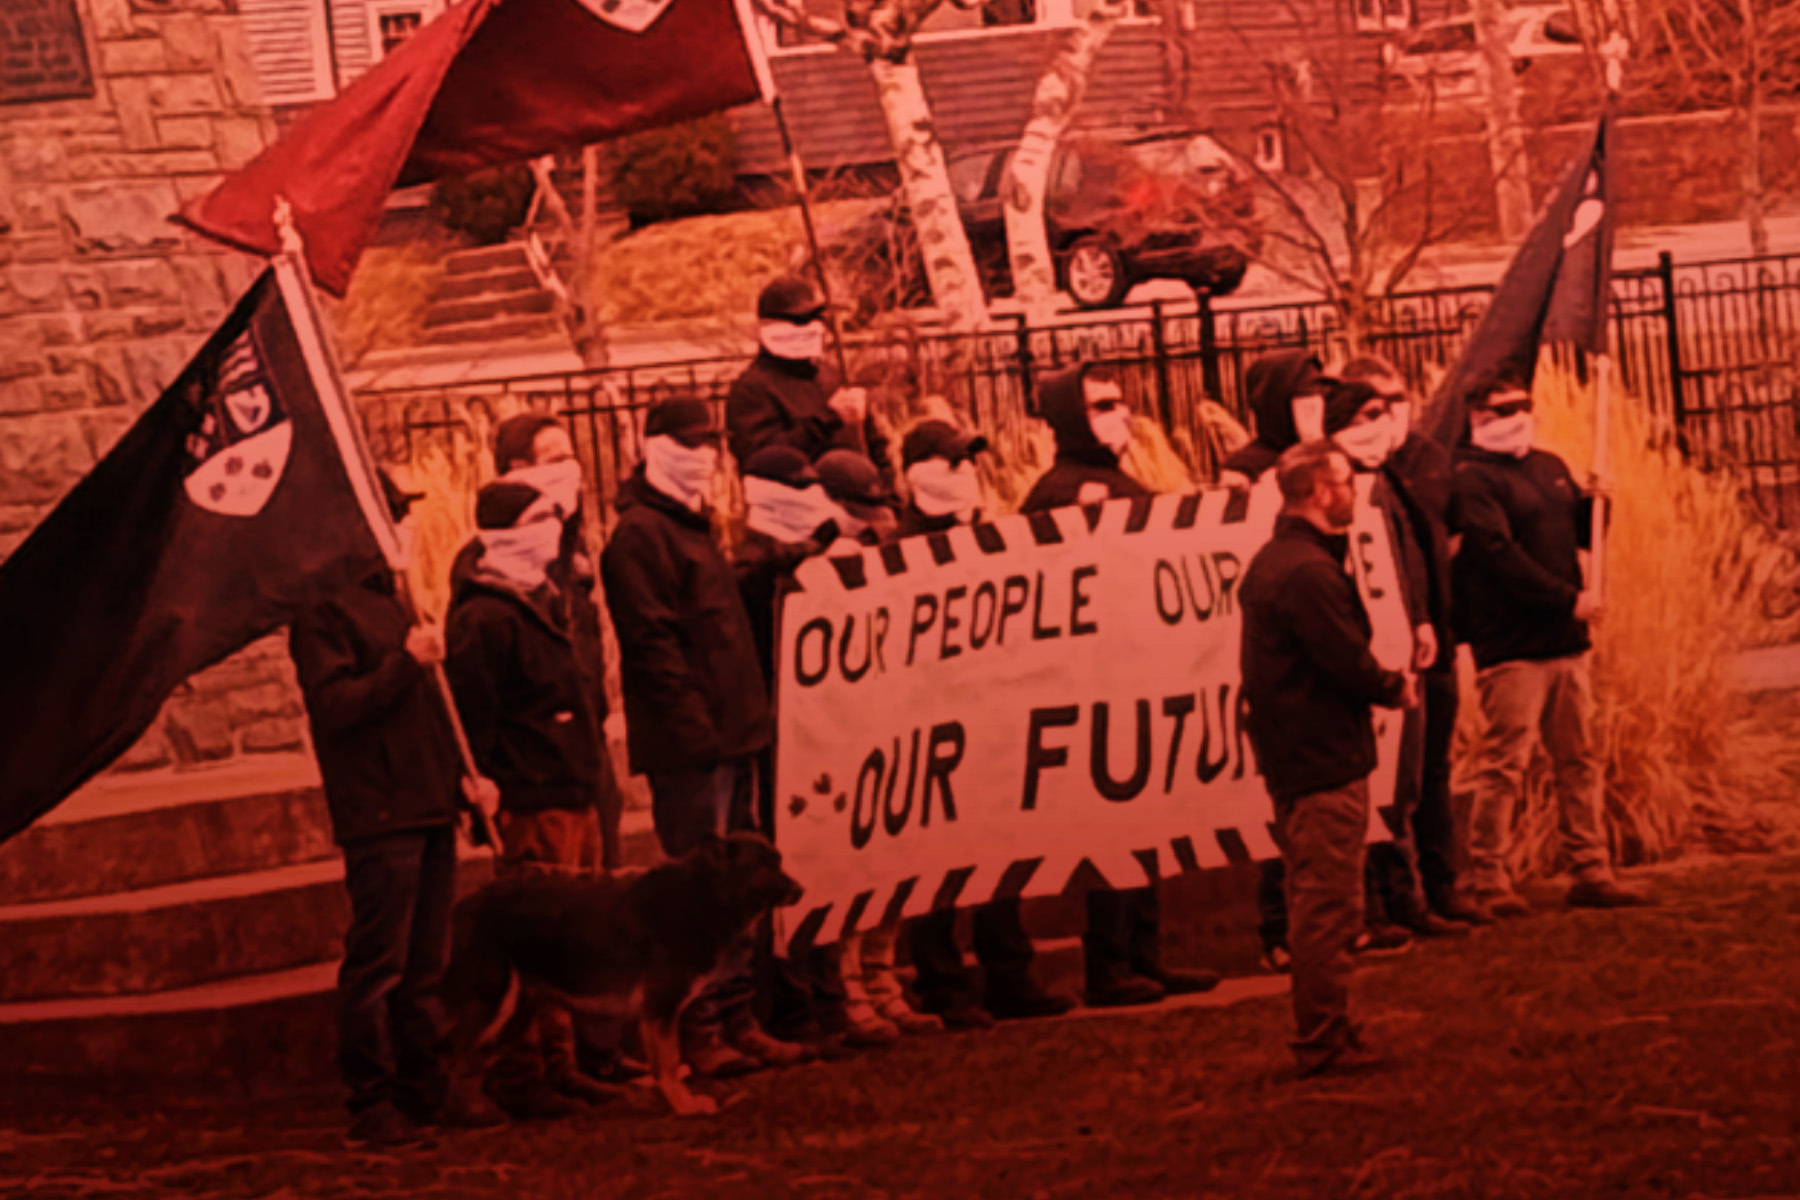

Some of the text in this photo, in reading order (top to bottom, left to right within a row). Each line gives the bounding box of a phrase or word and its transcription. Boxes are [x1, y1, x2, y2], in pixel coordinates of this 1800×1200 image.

[794, 550, 1241, 688] OUR PEOPLE OUR
[850, 718, 966, 851] OUR
